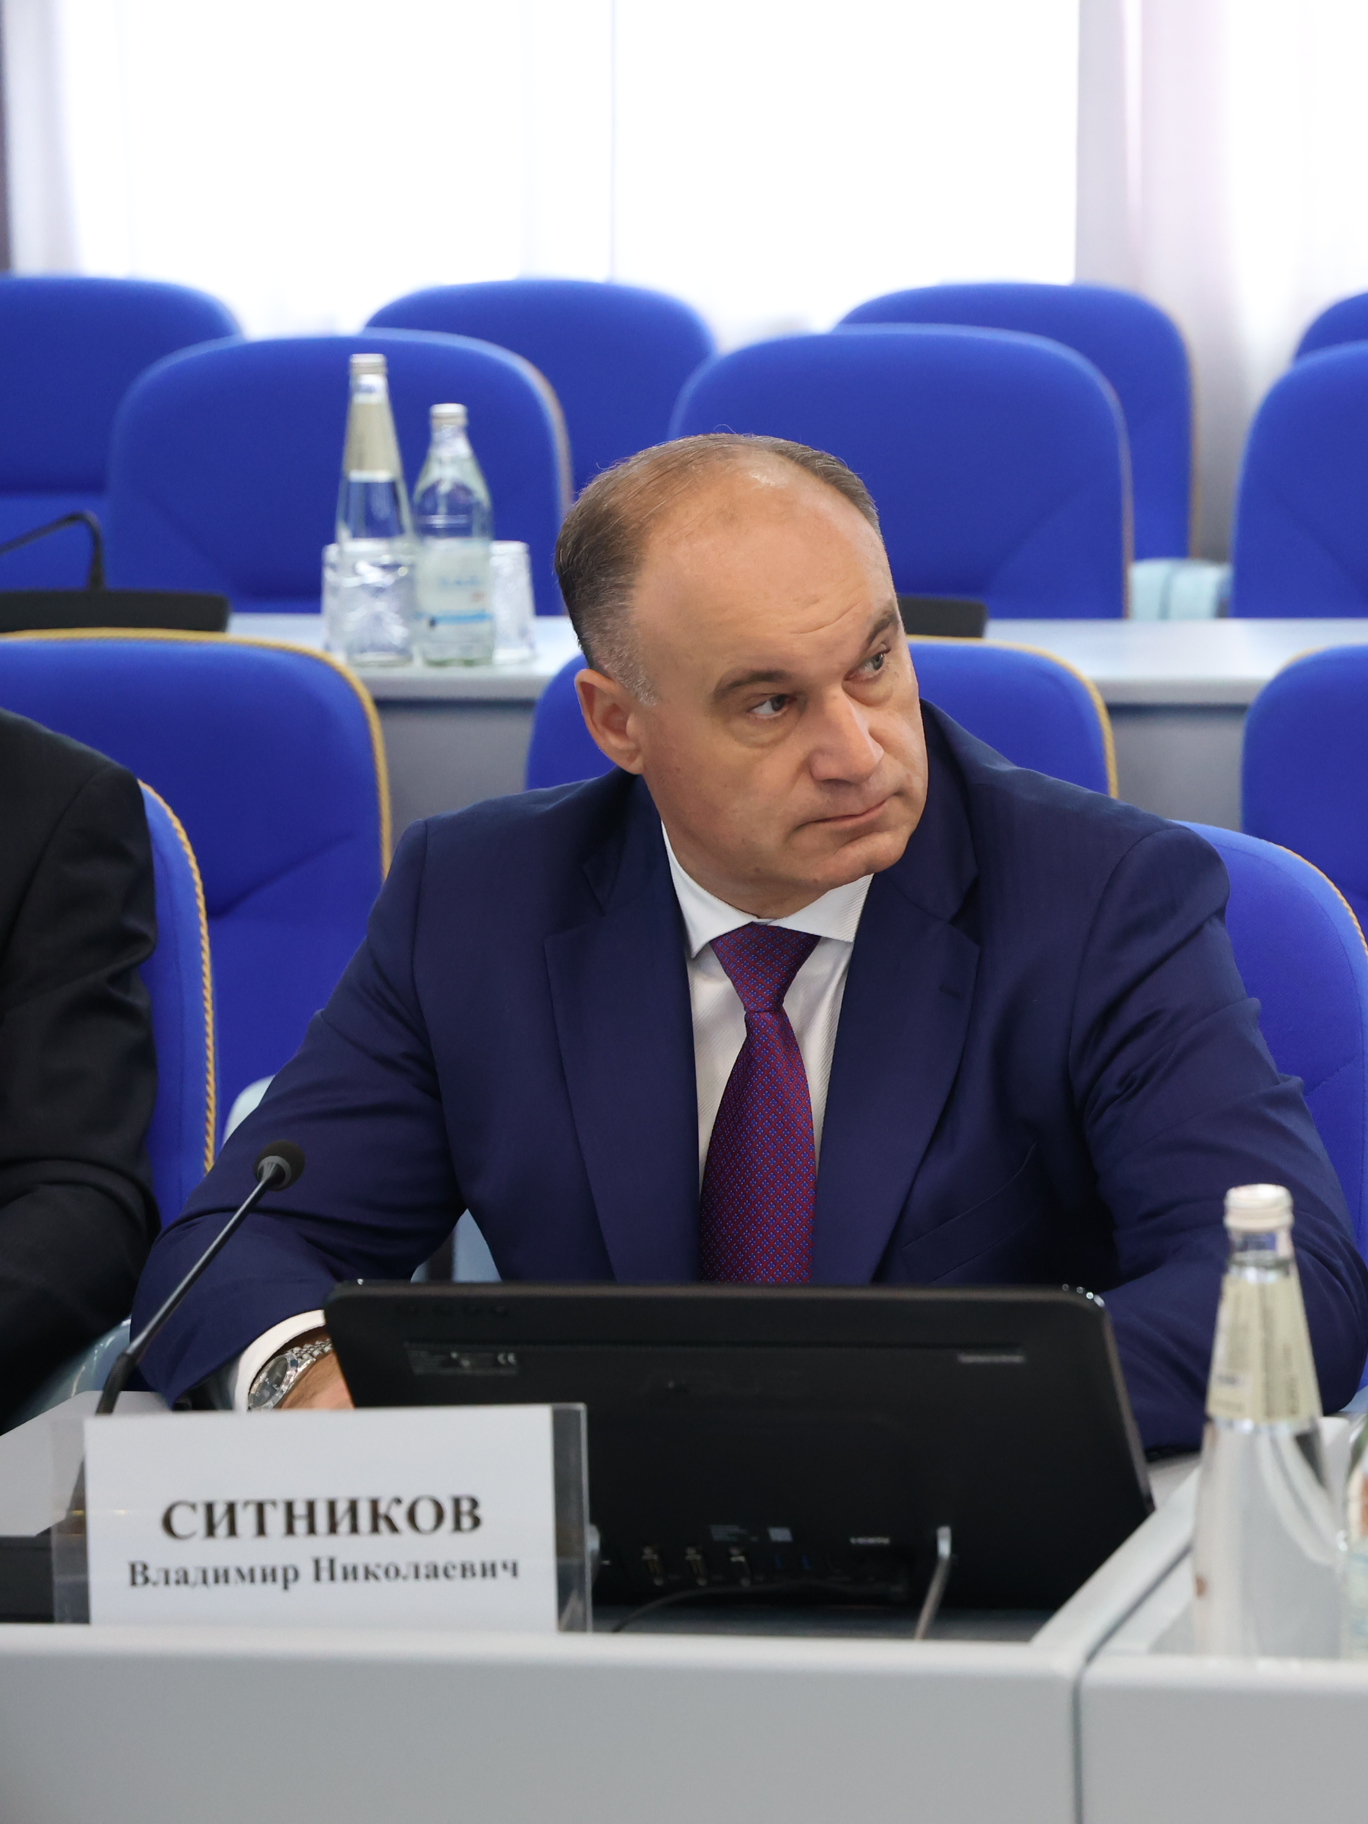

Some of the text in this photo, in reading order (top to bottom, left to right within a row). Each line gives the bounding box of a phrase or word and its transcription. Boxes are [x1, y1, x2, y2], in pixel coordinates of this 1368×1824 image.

[161, 1494, 482, 1540] СИТНИКОВ
[128, 1556, 519, 1592] Владимир Николаевич
